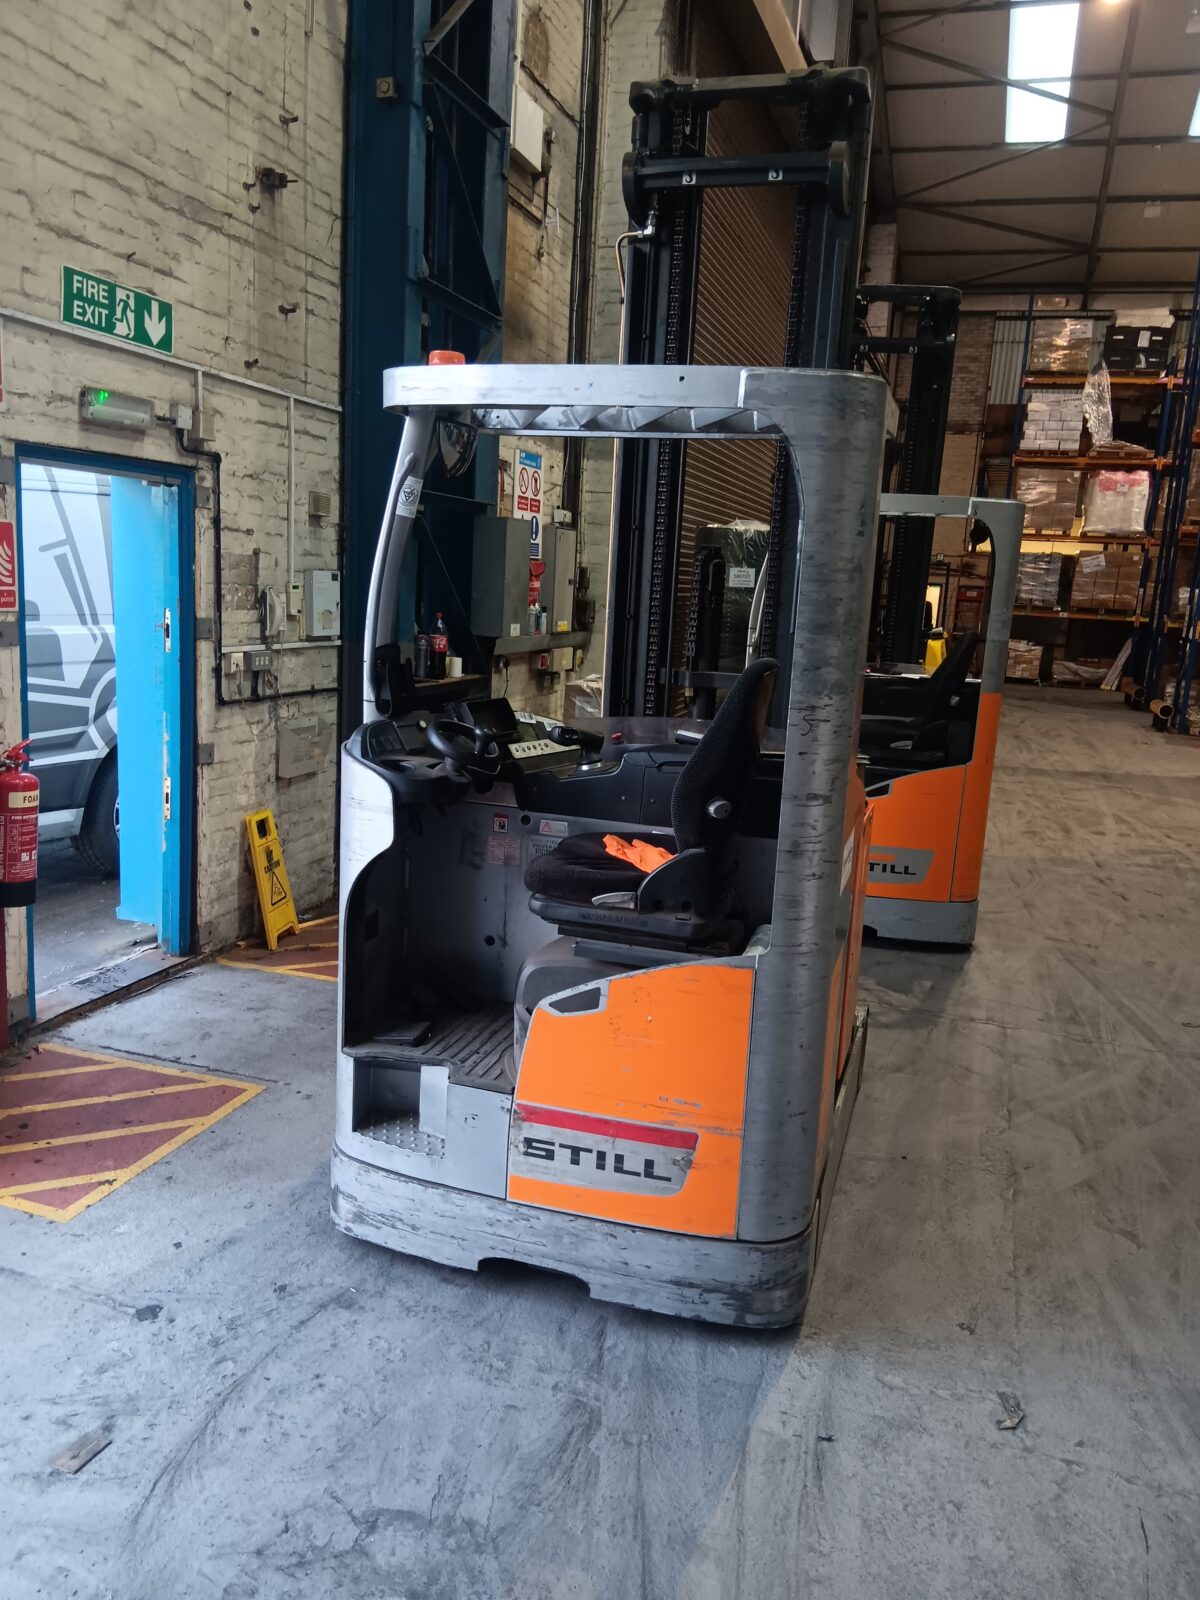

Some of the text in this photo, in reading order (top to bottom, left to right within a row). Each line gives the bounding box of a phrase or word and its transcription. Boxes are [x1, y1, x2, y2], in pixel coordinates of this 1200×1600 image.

[73, 274, 109, 304] FIRE
[73, 299, 109, 328] EXIT
[868, 862, 917, 876] TILL
[523, 1137, 672, 1182] STILL
